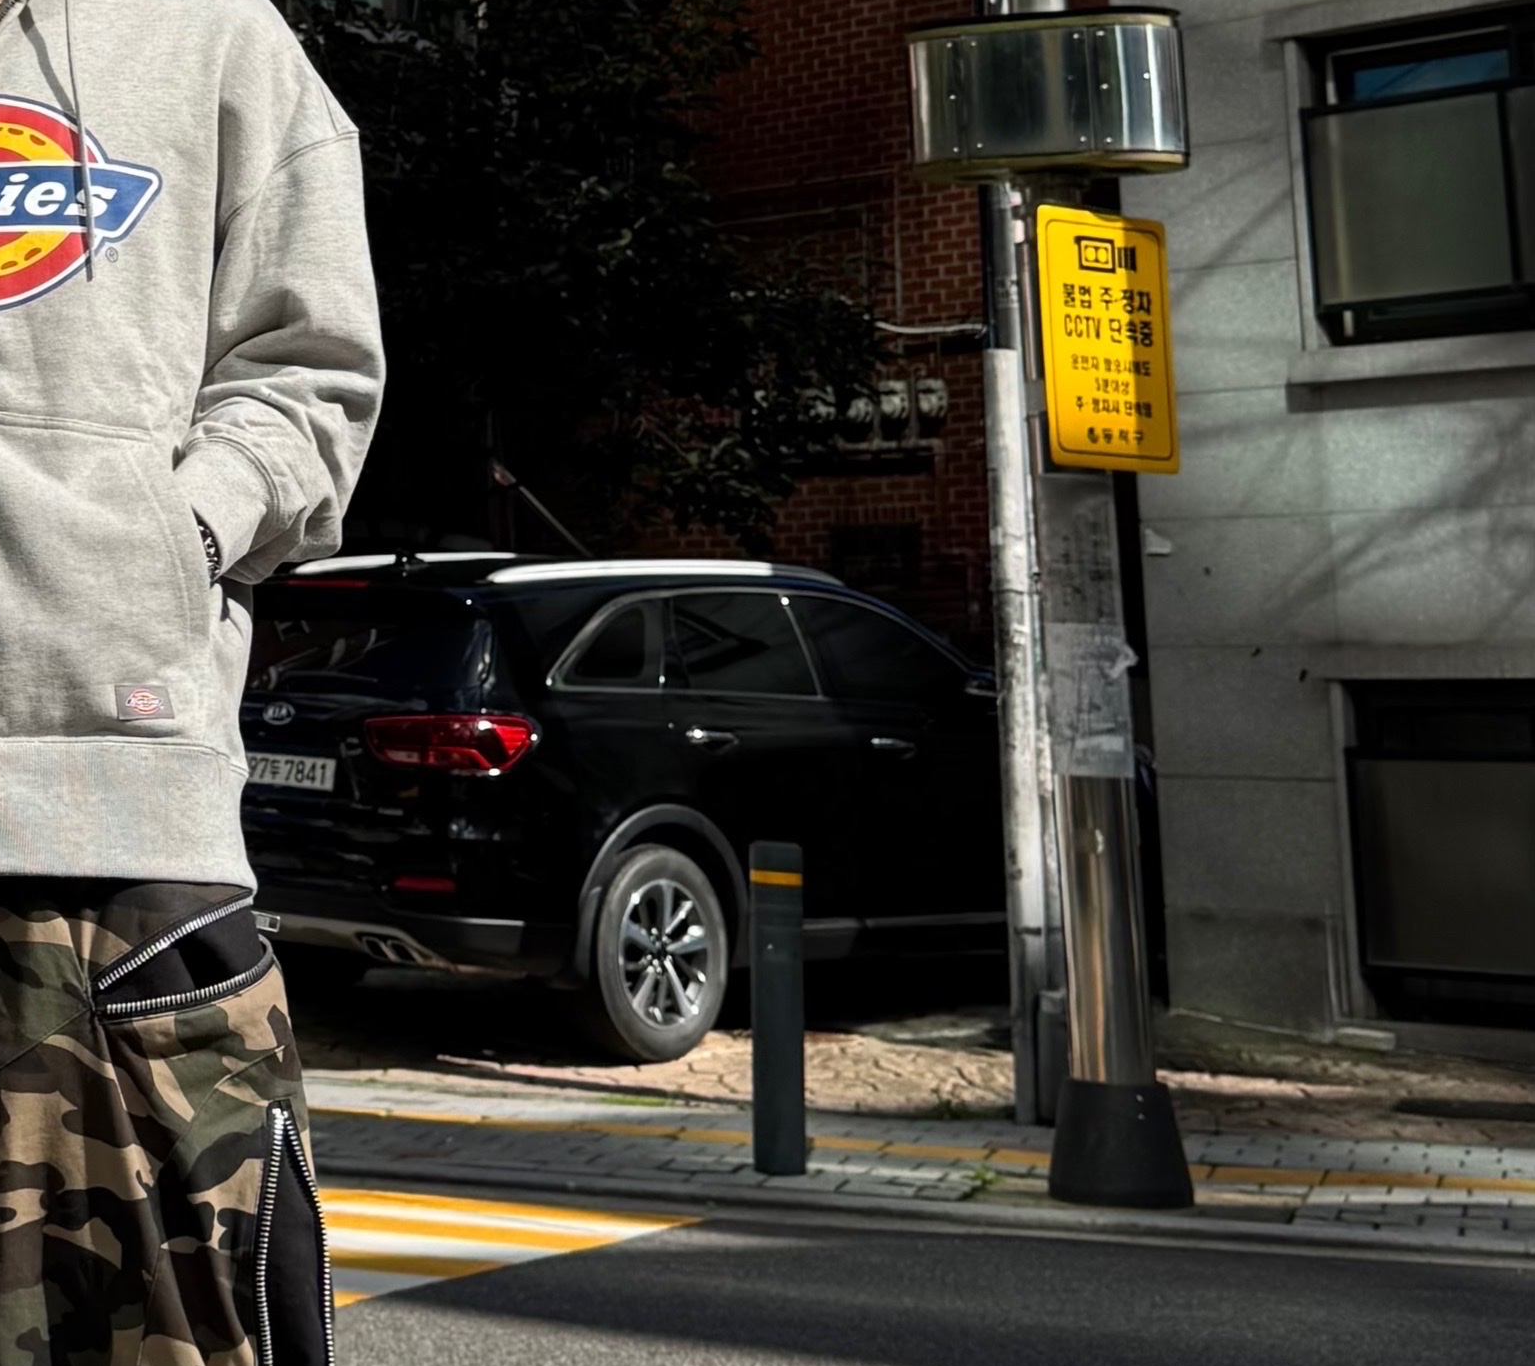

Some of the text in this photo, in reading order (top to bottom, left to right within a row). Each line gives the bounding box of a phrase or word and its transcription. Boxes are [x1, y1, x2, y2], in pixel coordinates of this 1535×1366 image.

[1062, 282, 1092, 310] 불법
[1064, 313, 1154, 348] CCTV 단속중
[1102, 427, 1145, 446] 동작구
[284, 758, 328, 787] 7841
